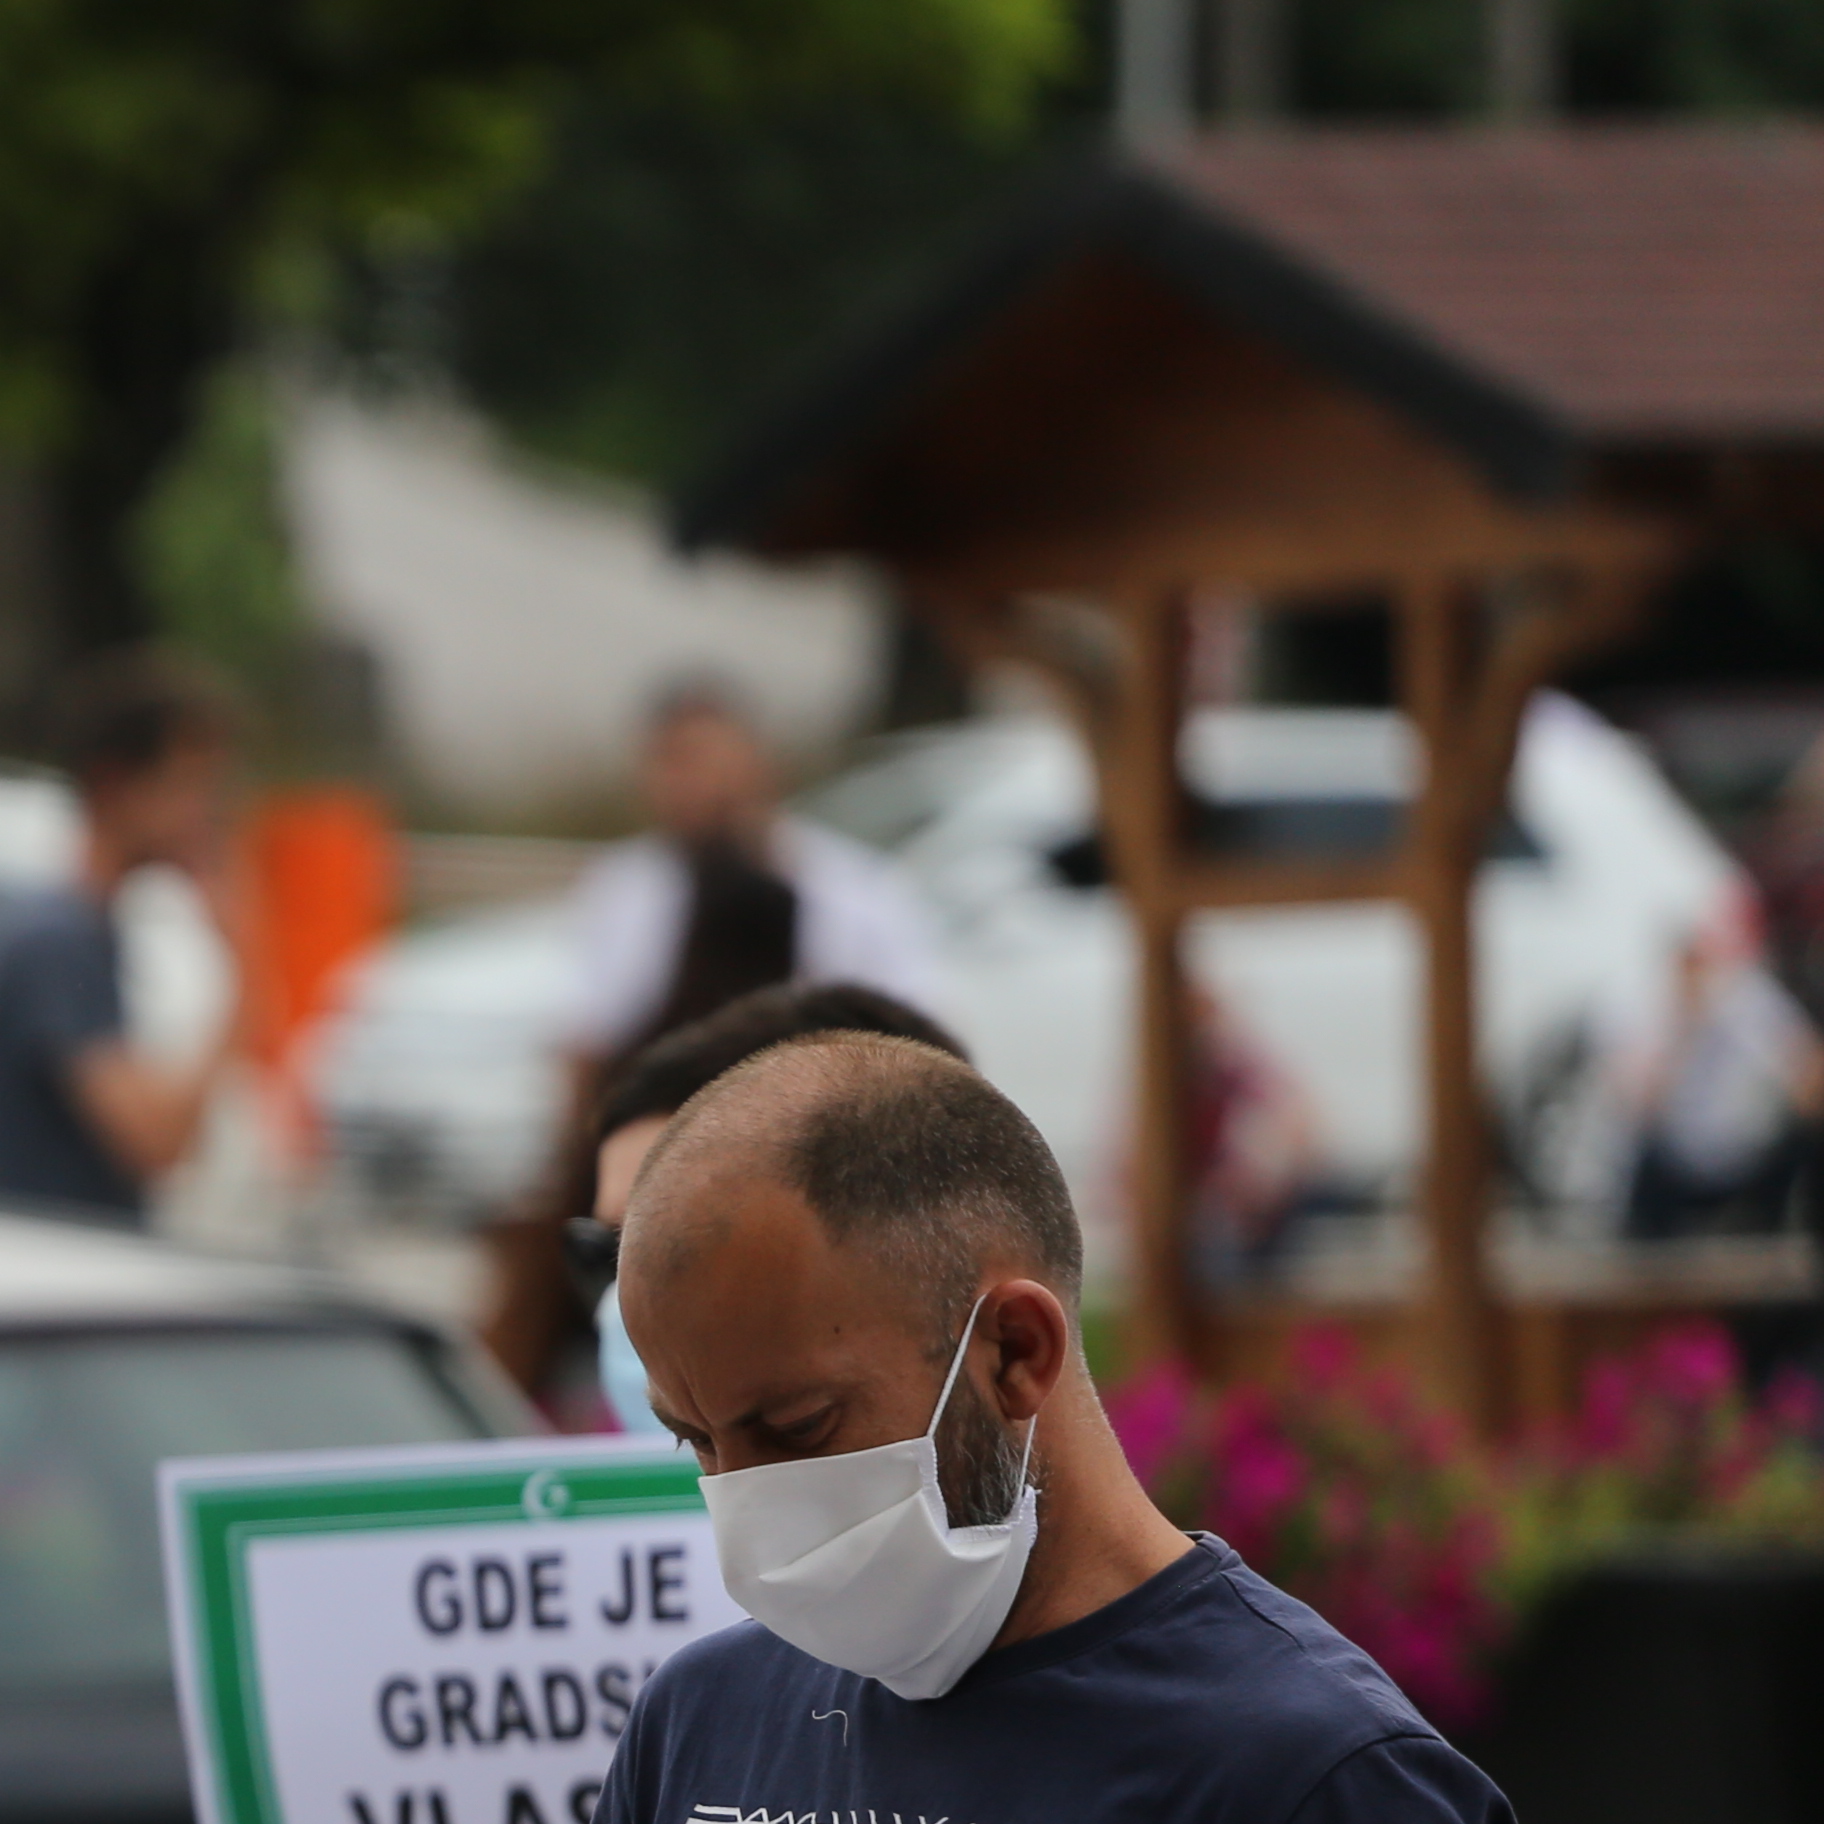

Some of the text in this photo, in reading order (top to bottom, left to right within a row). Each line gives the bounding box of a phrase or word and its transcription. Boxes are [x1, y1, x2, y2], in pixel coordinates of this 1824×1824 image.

[415, 1545, 690, 1638] GDE JE
[378, 1662, 648, 1753] GRADS
